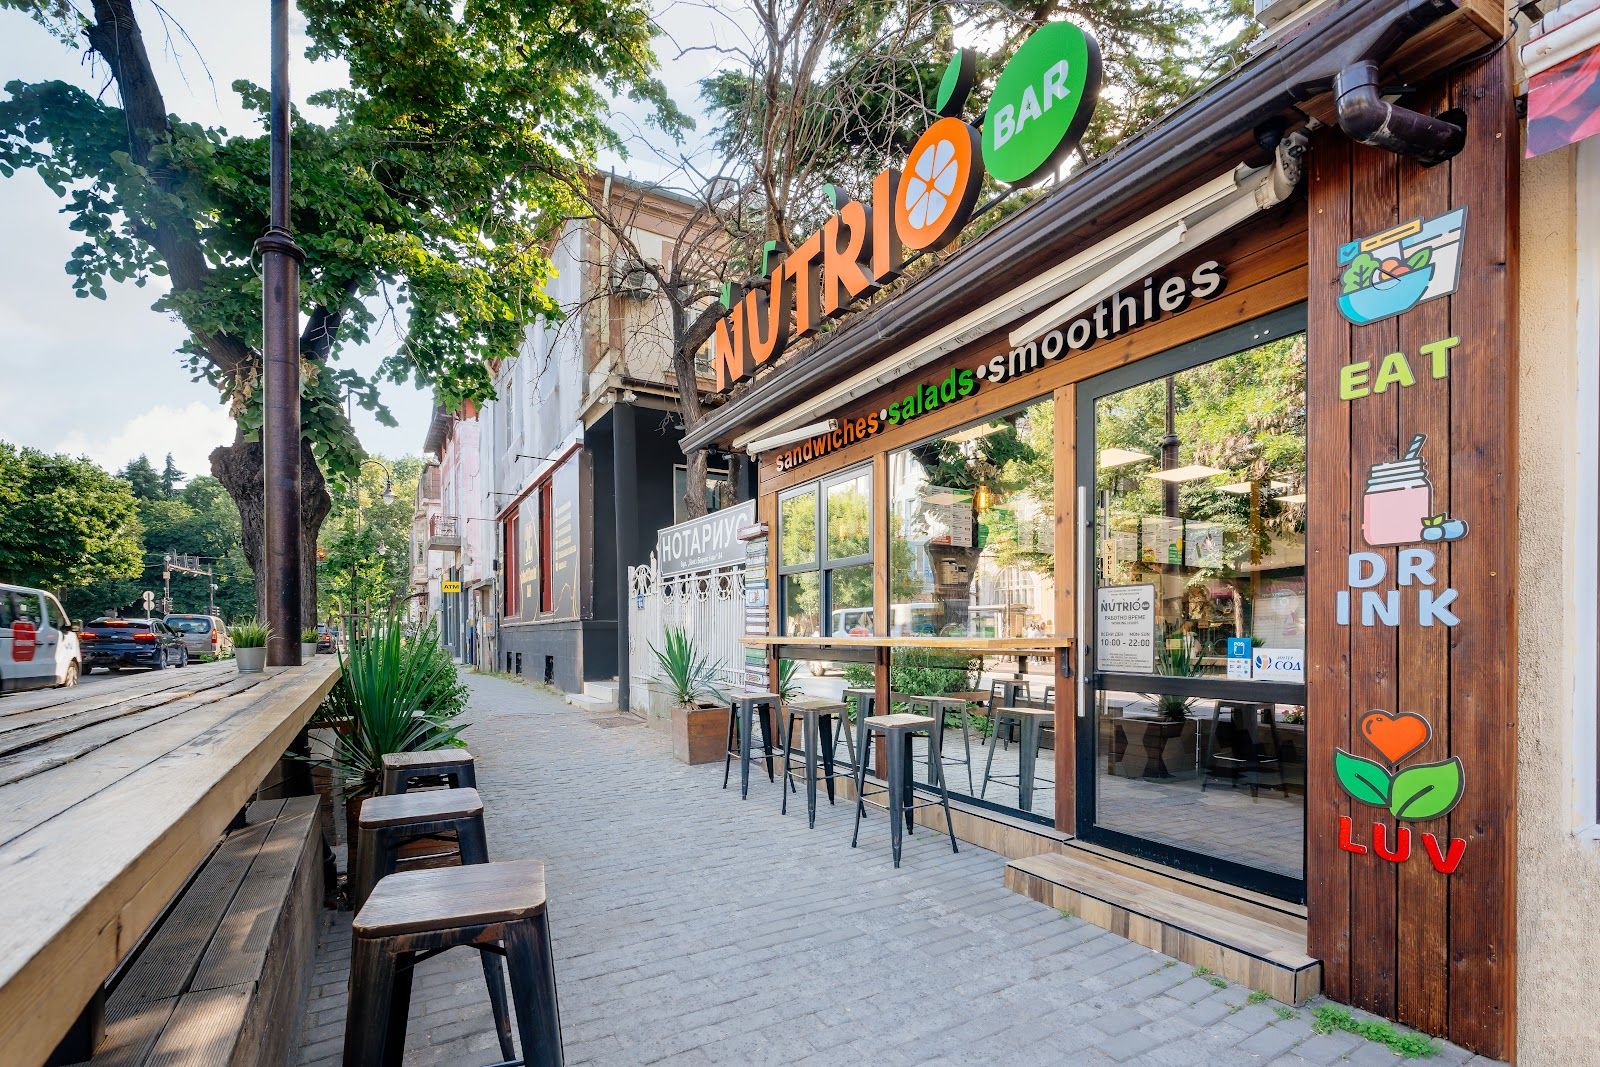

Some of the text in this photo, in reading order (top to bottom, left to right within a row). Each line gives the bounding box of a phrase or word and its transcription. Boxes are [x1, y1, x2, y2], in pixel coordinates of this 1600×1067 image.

[714, 59, 1071, 393] NUTRIO BAR
[776, 260, 1222, 472] sandwiches salads smoothies
[1340, 336, 1460, 400] EAT
[662, 512, 748, 562] НОТАРИУС
[1128, 639, 1150, 647] 22:00
[1339, 815, 1467, 874] LUV
